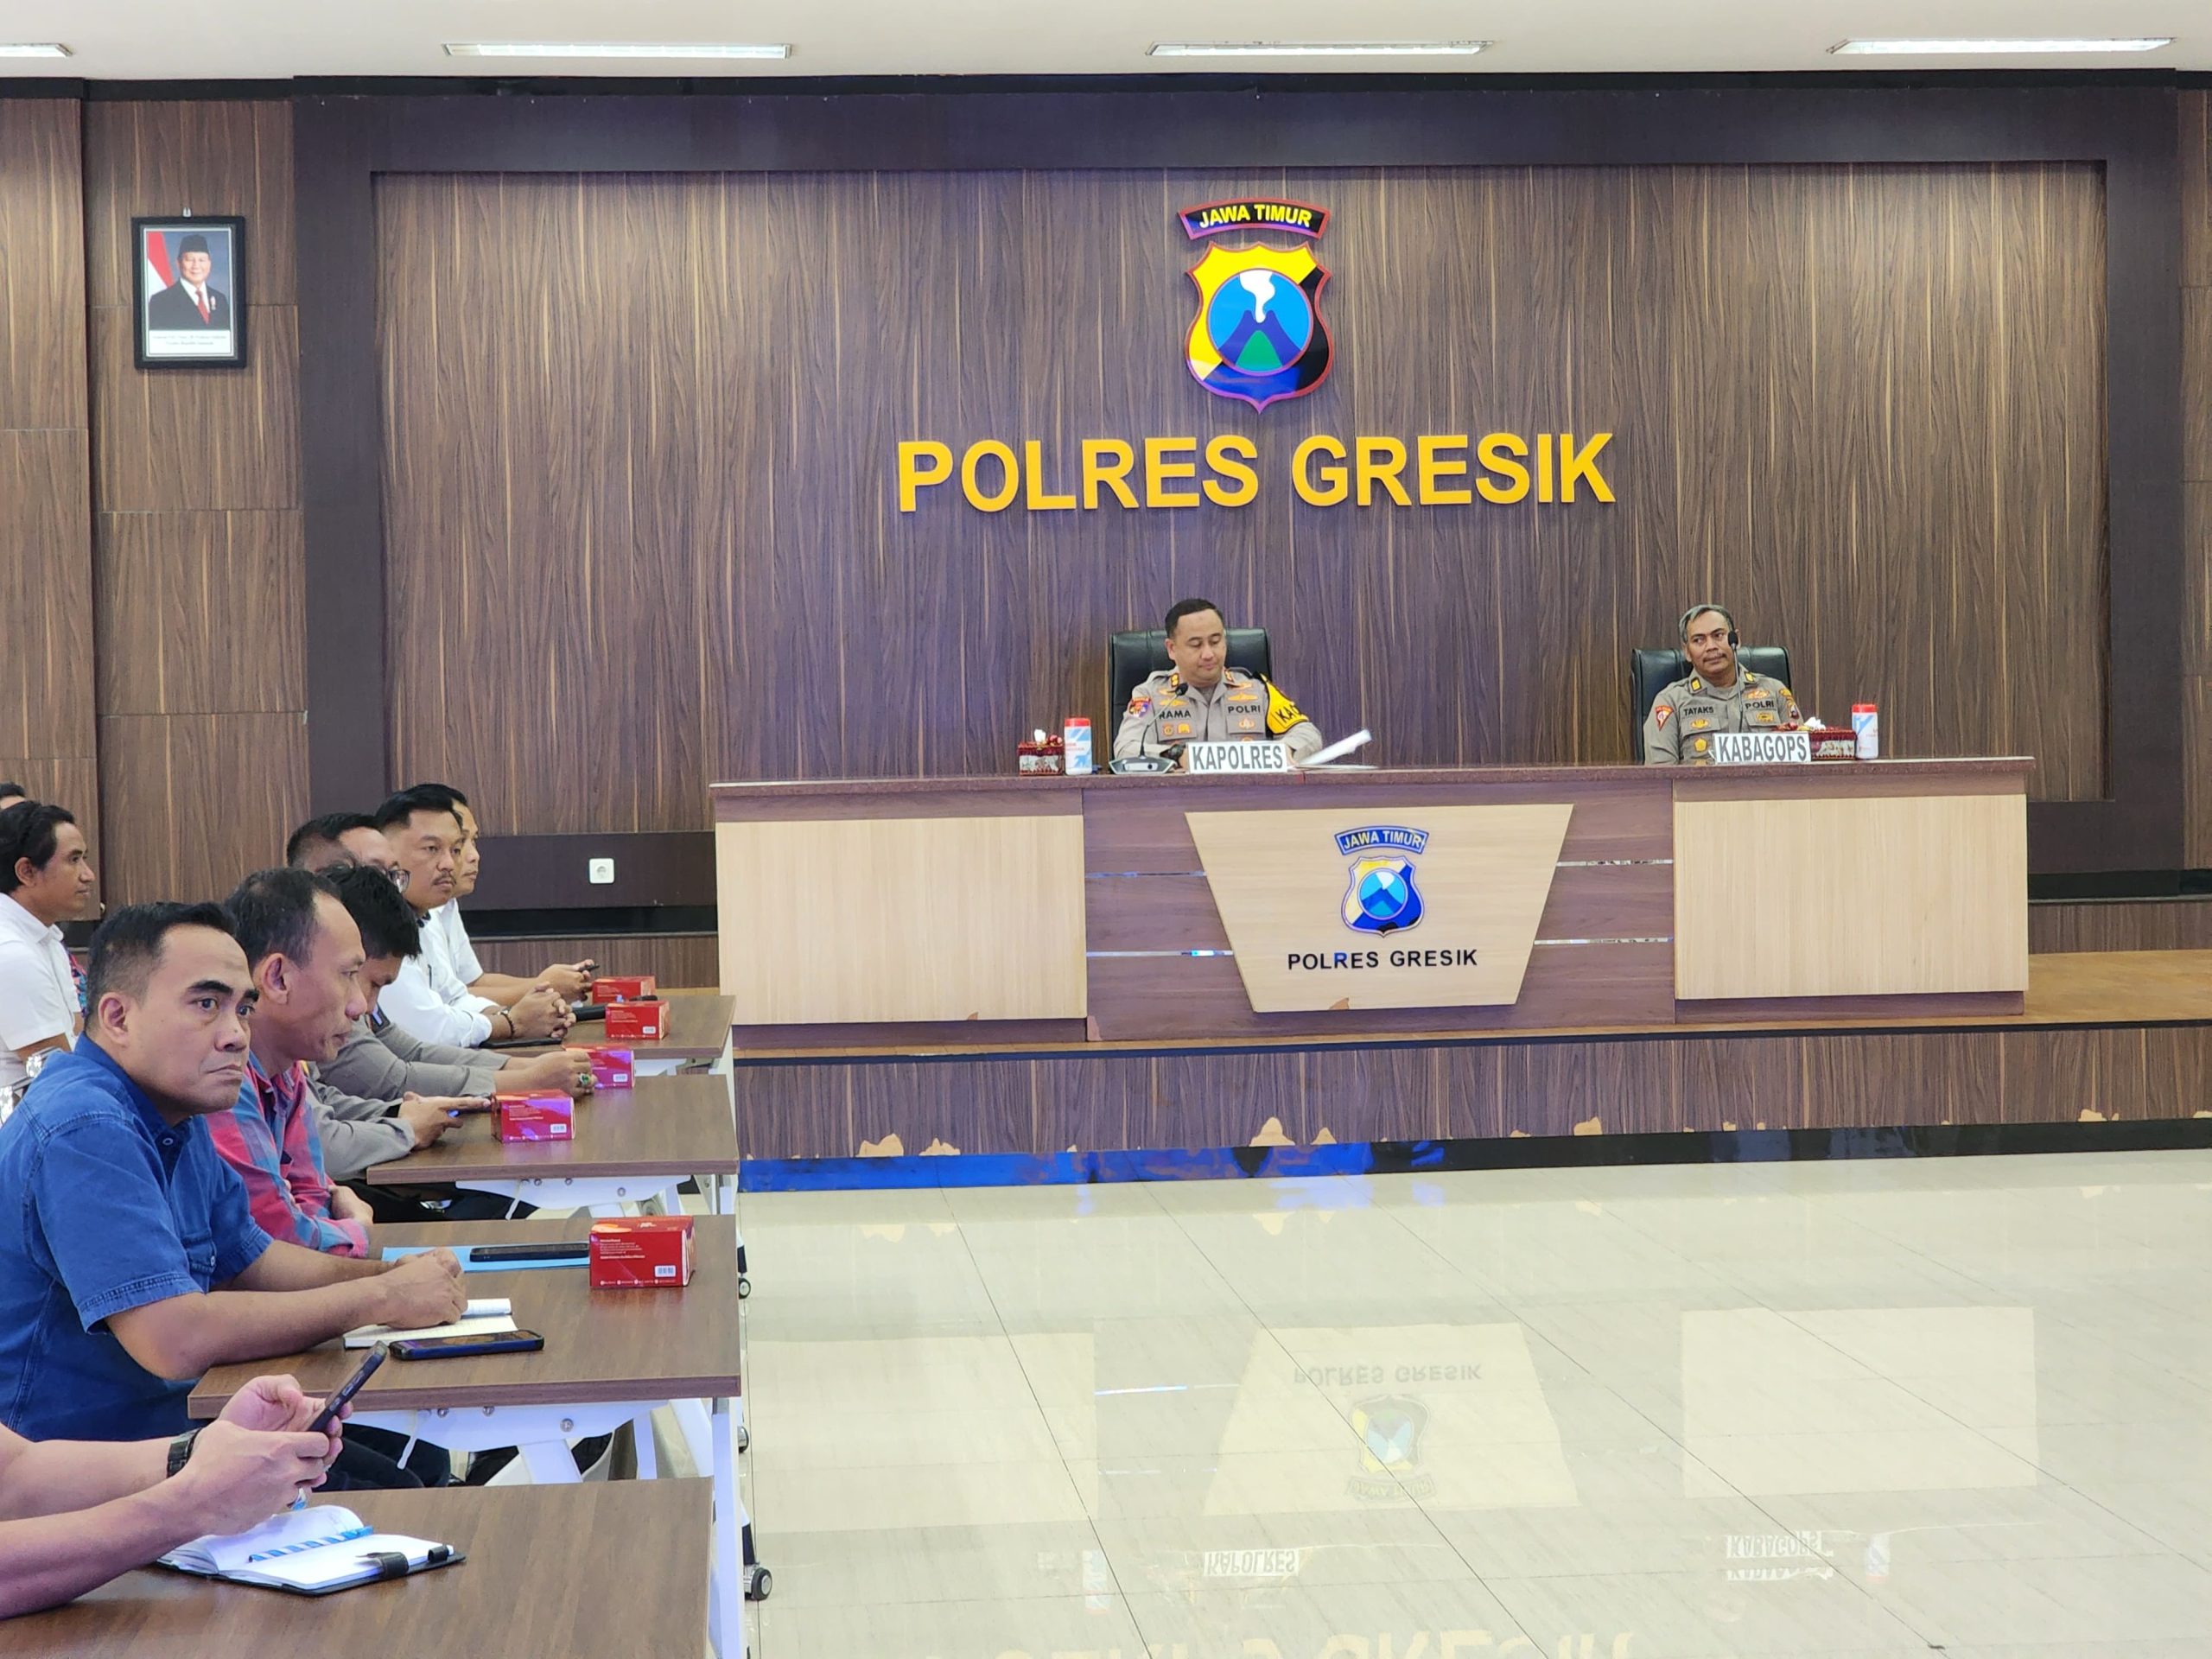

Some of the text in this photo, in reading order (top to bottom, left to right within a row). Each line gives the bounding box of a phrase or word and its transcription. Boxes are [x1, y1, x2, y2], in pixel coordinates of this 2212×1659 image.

[1199, 204, 1313, 228] JAWA TIMUR
[899, 433, 1617, 512] POLRES GRESIK
[1159, 709, 1192, 720] RAMA
[1227, 704, 1261, 714] POLRI
[1683, 706, 1714, 716] TATAKS
[1745, 700, 1775, 709] POLRI
[1192, 744, 1284, 771] KAPOLRES
[1718, 734, 1808, 762] KABAGOPS
[1344, 830, 1422, 849] JAWA TIMUR
[1287, 949, 1478, 970] POLRES GRESIK
